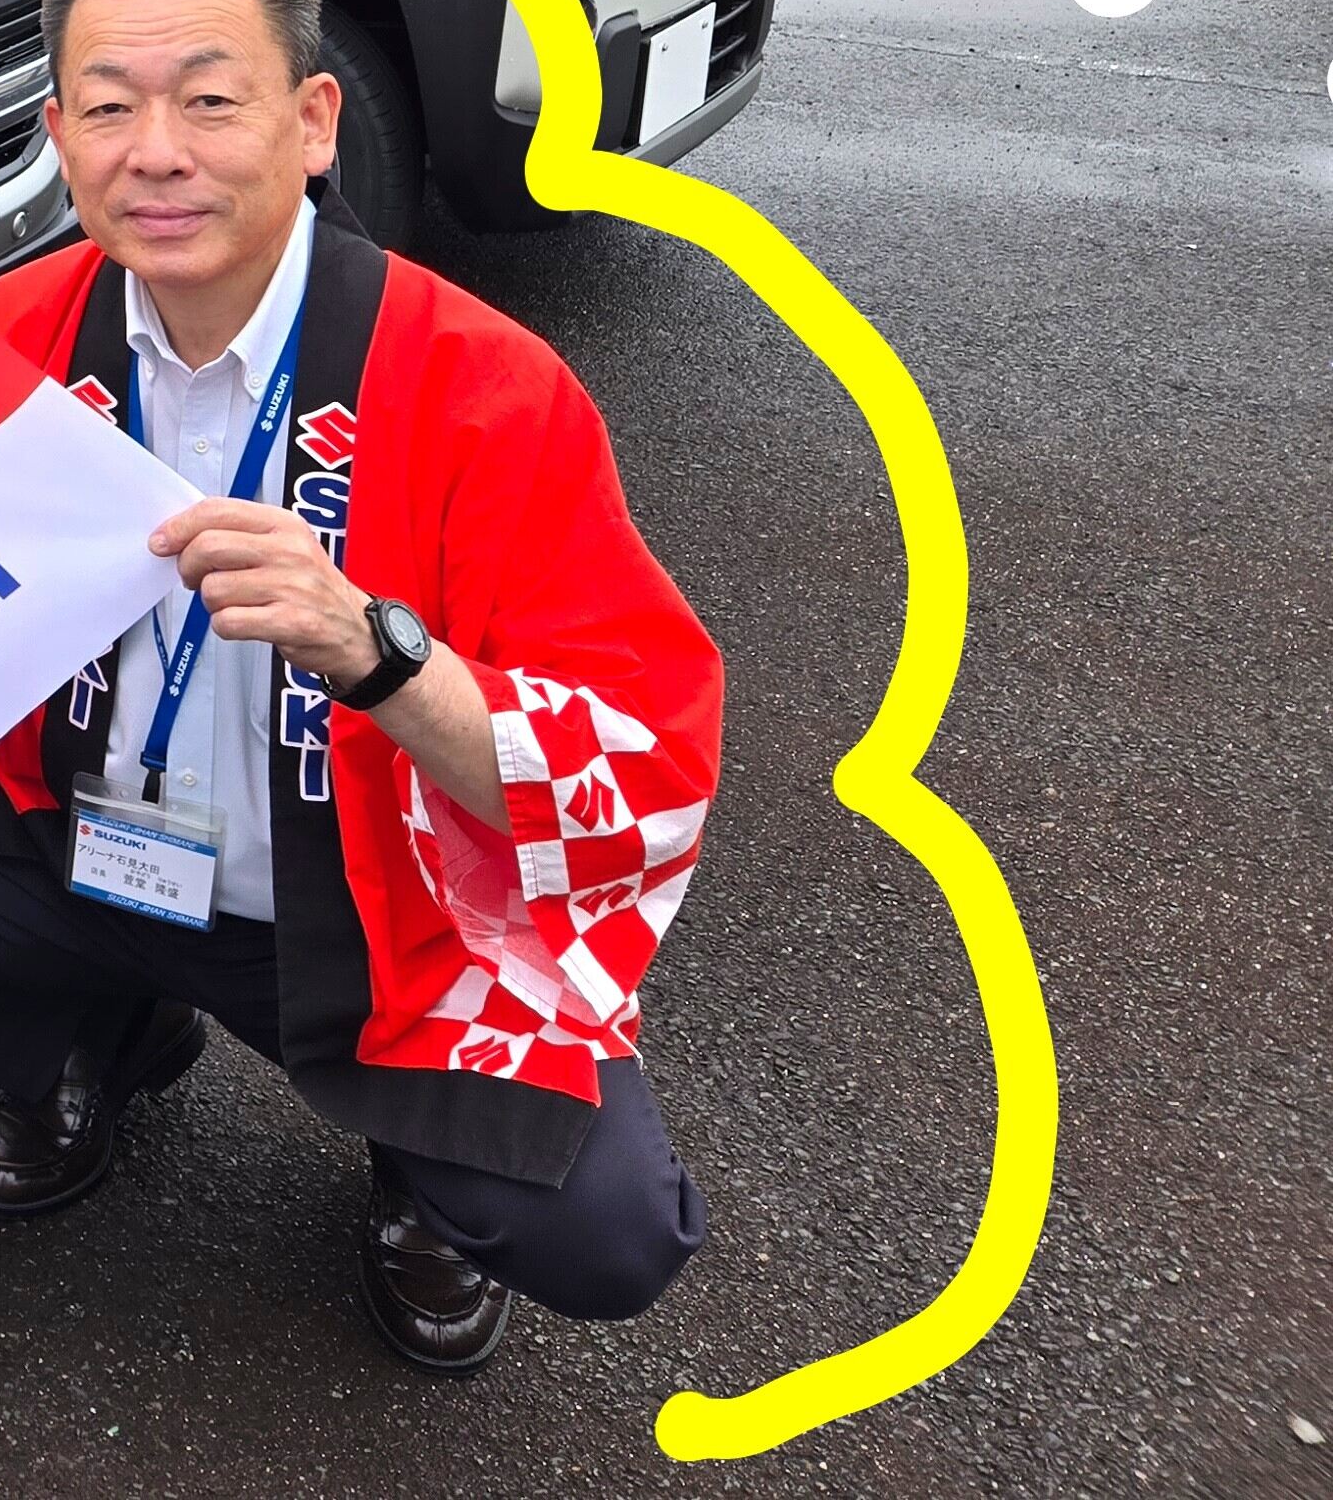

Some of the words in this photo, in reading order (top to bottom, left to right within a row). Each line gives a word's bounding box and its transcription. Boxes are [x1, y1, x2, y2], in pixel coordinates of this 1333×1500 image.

[266, 373, 290, 420] SUZUKI
[173, 641, 194, 685] SUZUKI
[94, 829, 147, 851] SUZUKI
[77, 843, 161, 876] アリーナ石見大田
[107, 893, 140, 909] SUZUKI
[139, 904, 167, 918] JIHAN
[166, 911, 207, 929] SHIMANE
